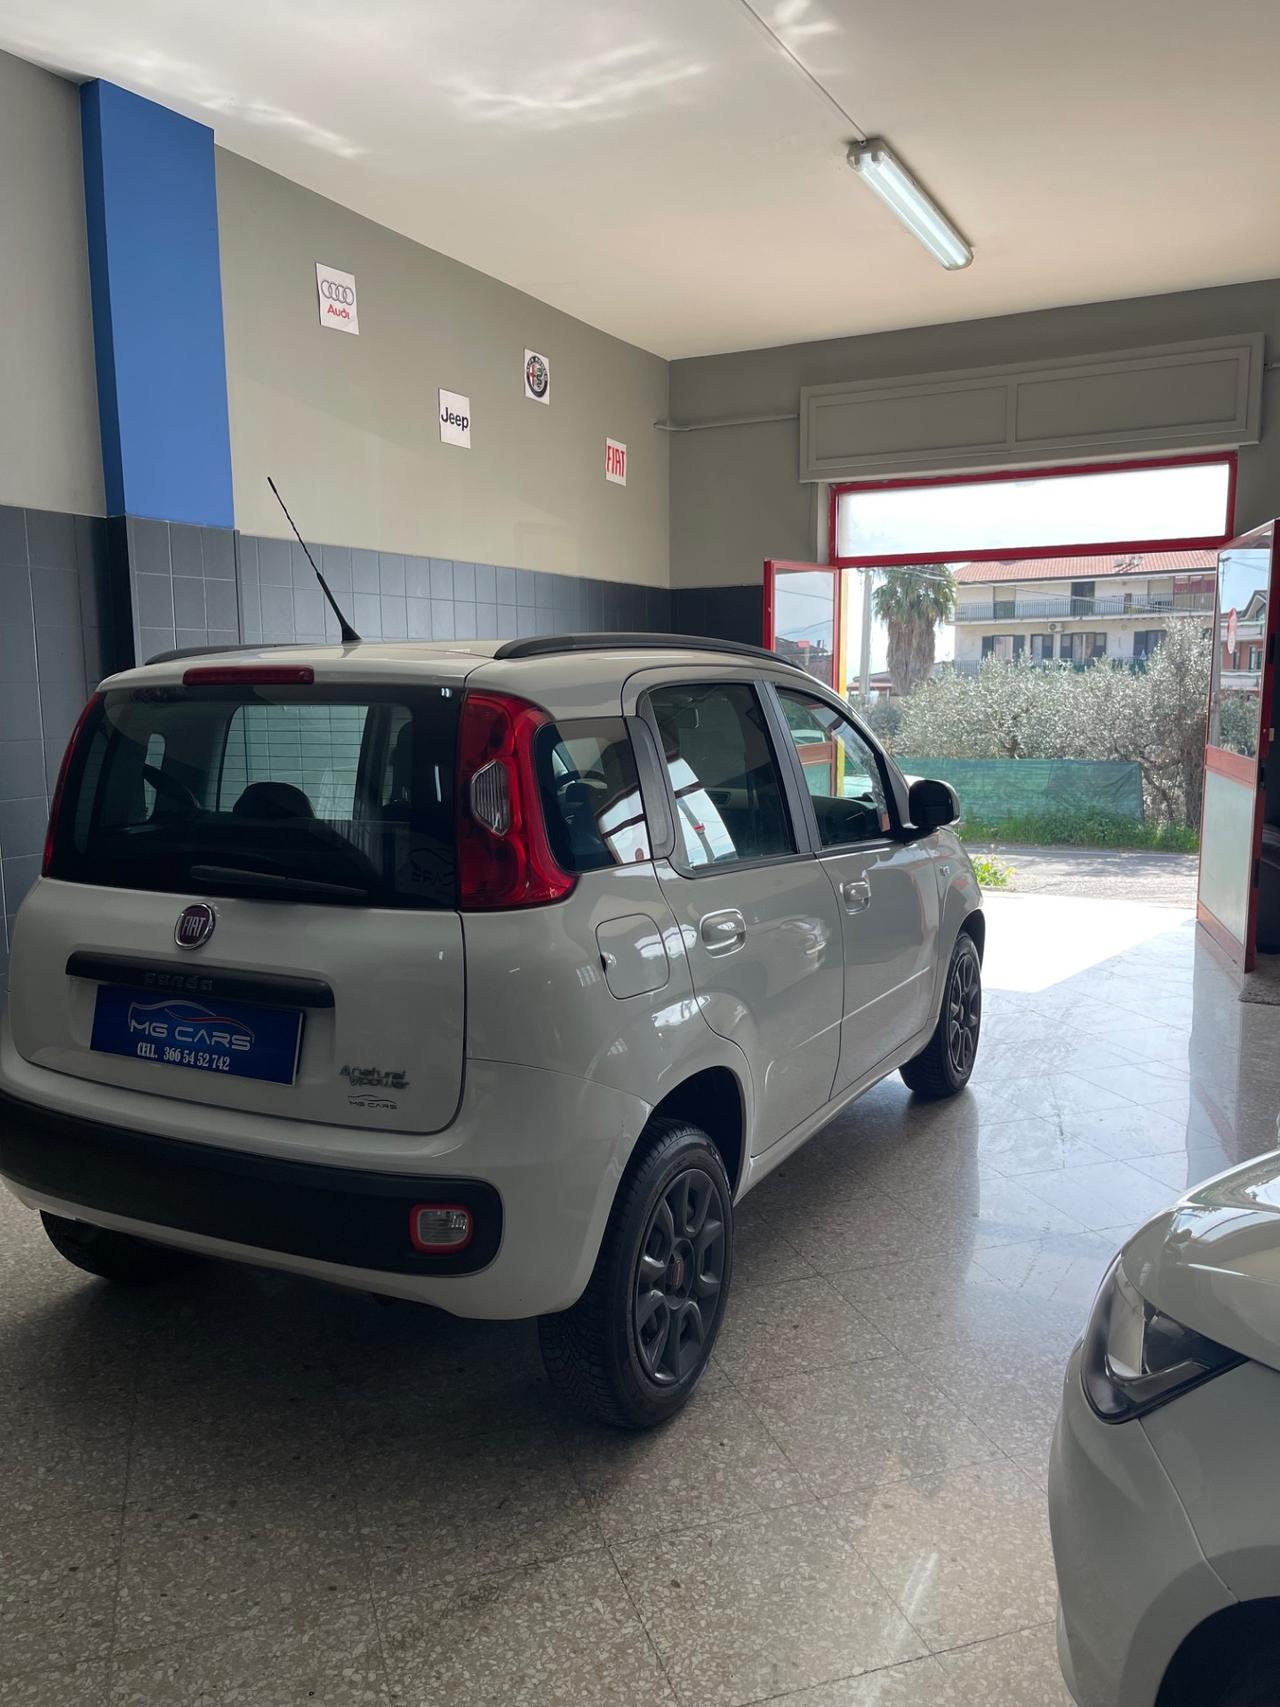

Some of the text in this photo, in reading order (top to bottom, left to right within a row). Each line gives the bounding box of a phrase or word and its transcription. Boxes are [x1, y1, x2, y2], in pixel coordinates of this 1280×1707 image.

[327, 303, 350, 319] Audi
[441, 406, 469, 432] Jeep
[606, 445, 625, 478] FIAT
[181, 916, 206, 937] FIAT
[130, 1018, 251, 1051] MG CARS
[137, 1041, 230, 1071] CELL. 366 54 52 742
